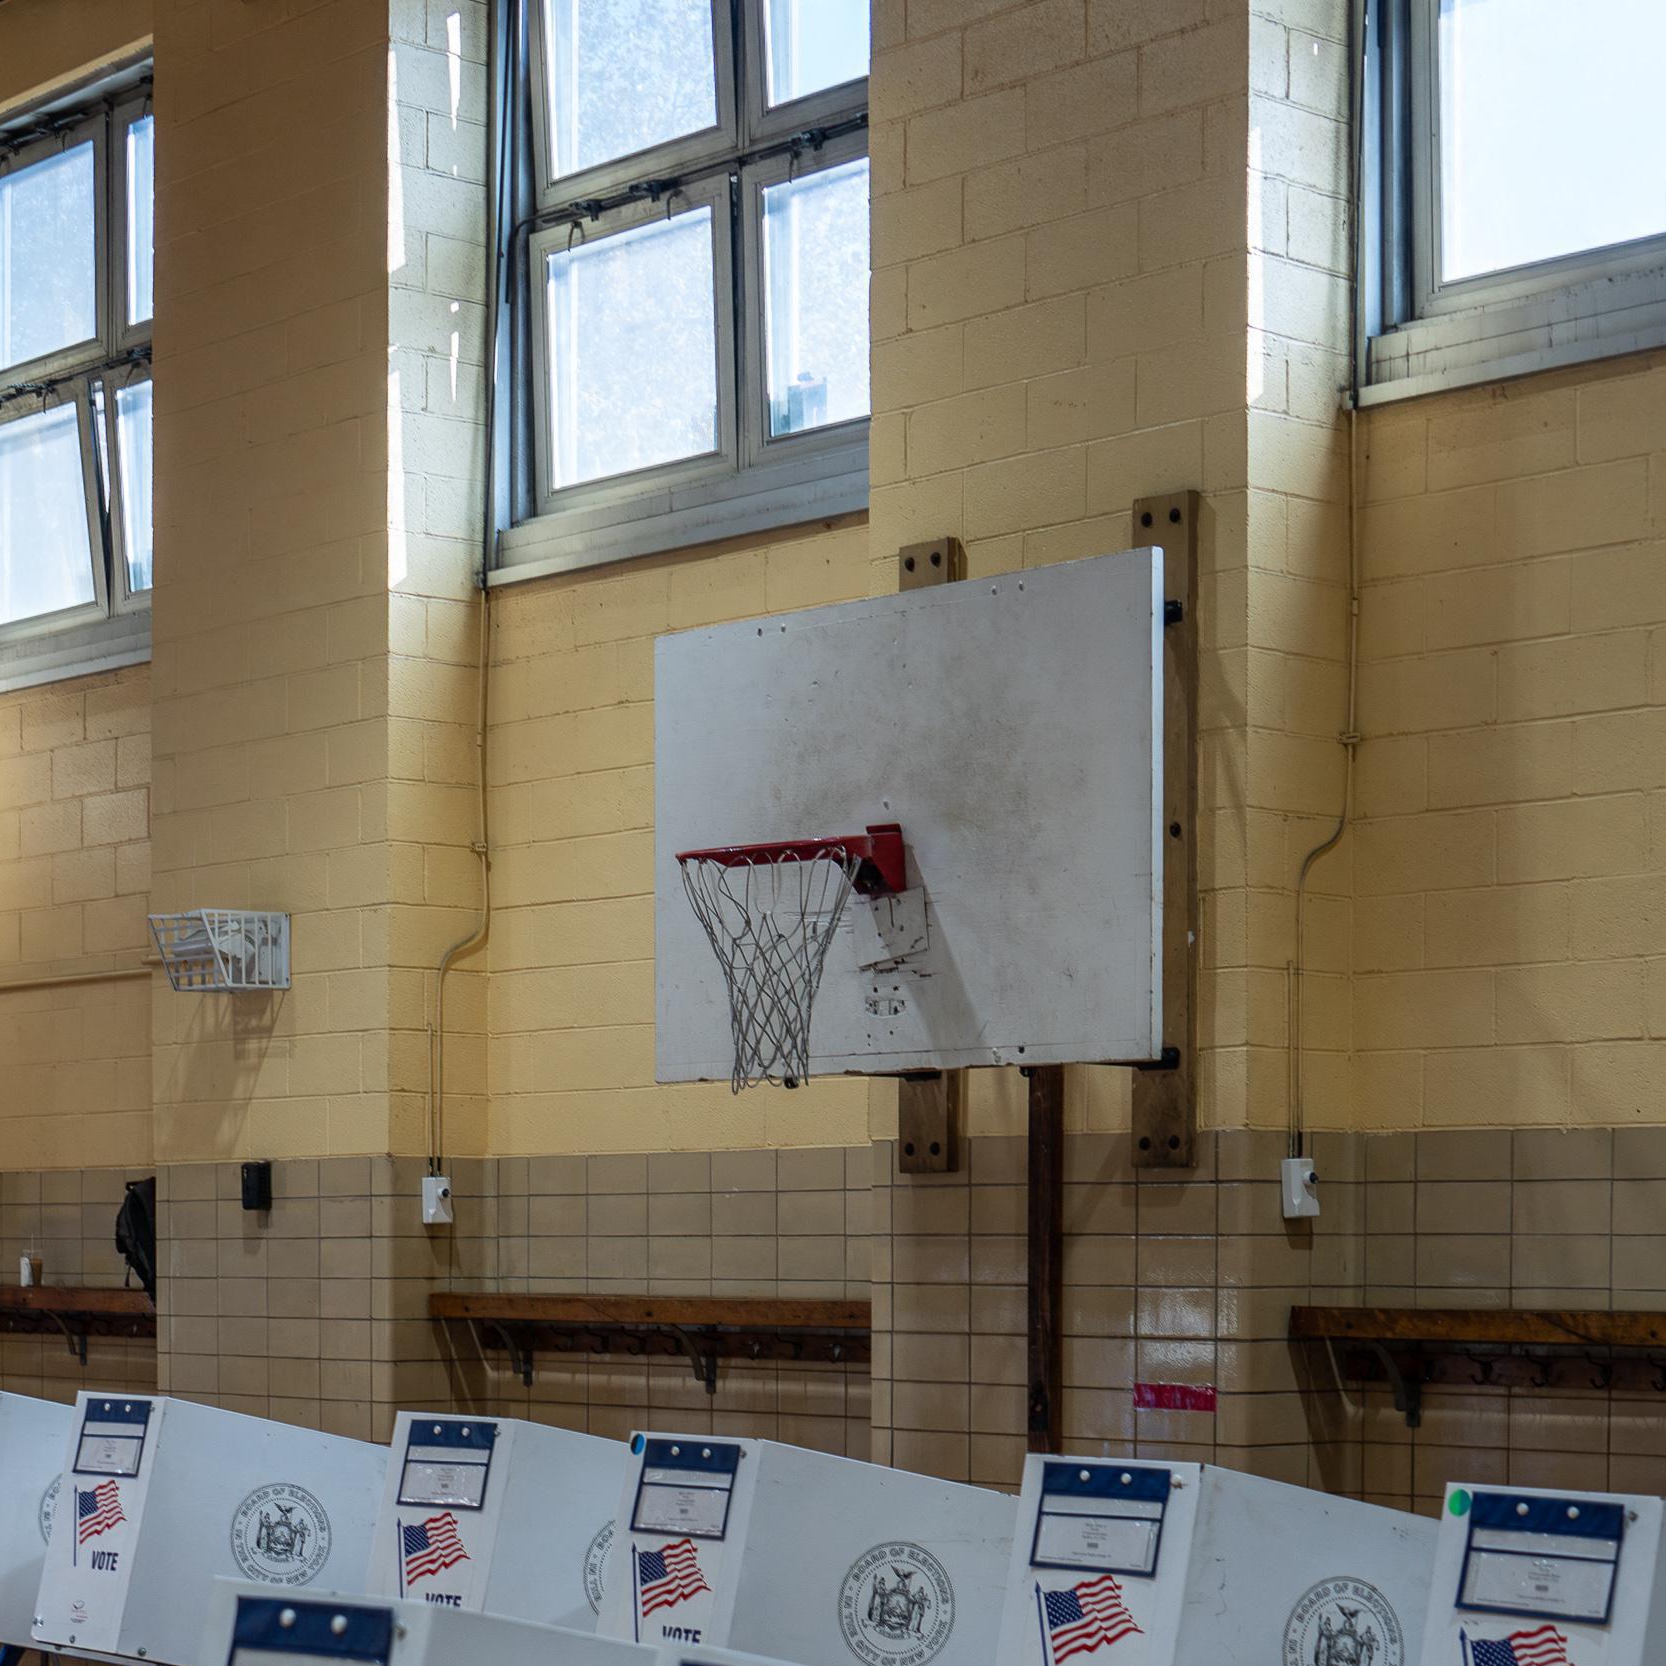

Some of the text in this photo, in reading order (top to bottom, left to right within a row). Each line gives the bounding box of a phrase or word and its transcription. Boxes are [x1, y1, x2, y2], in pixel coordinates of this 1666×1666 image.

[91, 1550, 119, 1572] VOTE
[852, 1548, 949, 1605] BOARD OF ELECTIONS
[844, 1596, 948, 1666] IN THE CITY OF NEW YORK
[1296, 1583, 1397, 1646] BOARD OF ELECTIONS
[1288, 1639, 1298, 1654] IN
